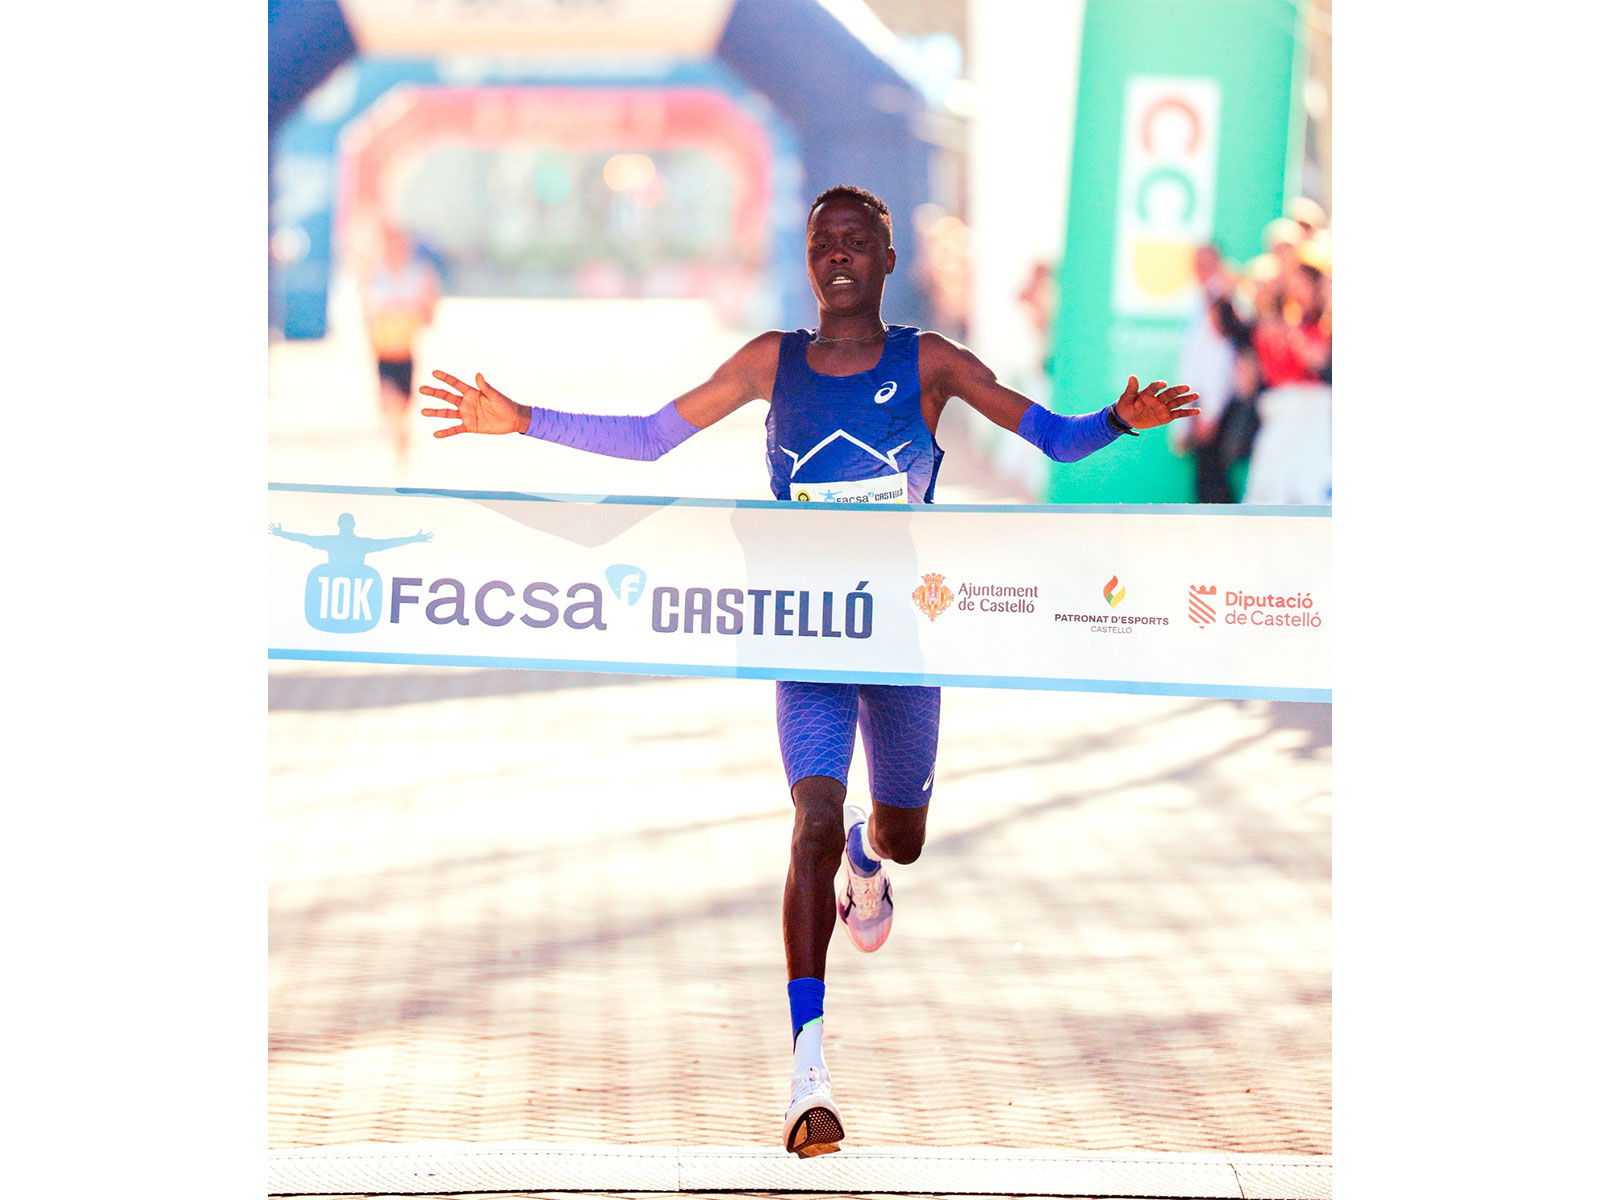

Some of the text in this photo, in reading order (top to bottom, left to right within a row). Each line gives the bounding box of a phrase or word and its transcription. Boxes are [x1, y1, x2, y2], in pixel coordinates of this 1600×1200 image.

[958, 582, 1039, 599] Ajuntament
[318, 576, 374, 621] 10K
[390, 576, 607, 631] Facsa
[651, 581, 874, 639] CASTELLÓ
[958, 597, 1035, 613] de Castelló
[1225, 590, 1313, 610] Diputació
[1054, 613, 1169, 625] PATRONAT D'ESPORTS
[1225, 609, 1322, 627] de Castelló
